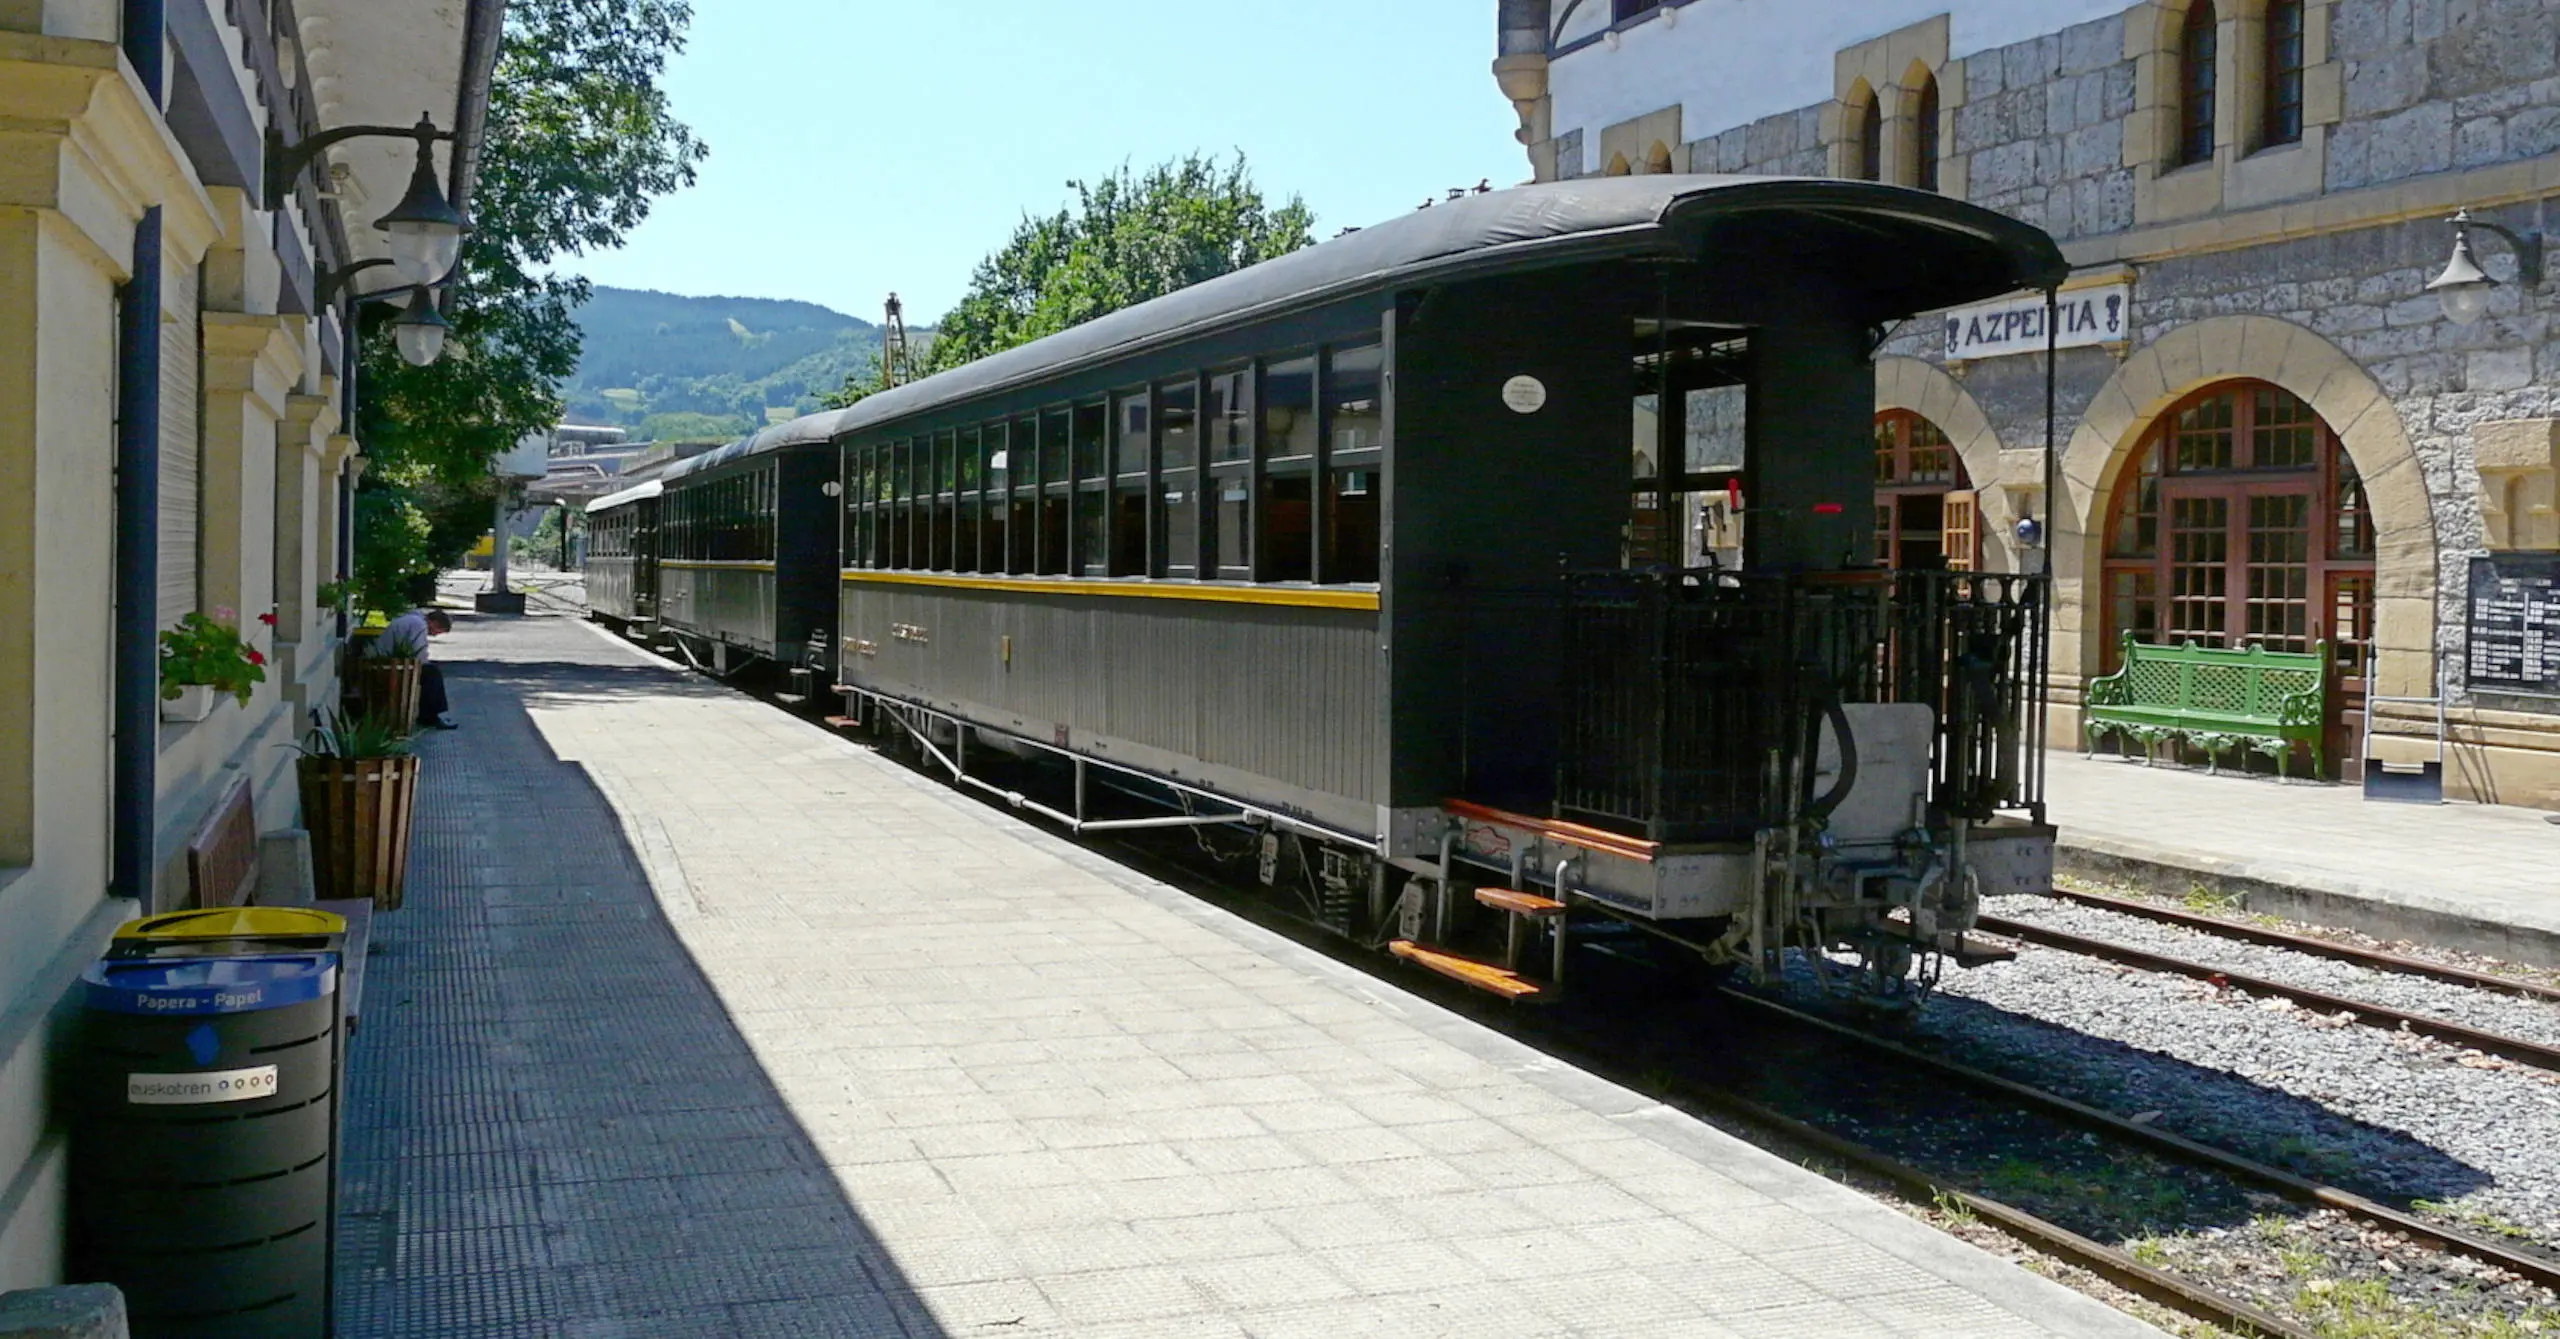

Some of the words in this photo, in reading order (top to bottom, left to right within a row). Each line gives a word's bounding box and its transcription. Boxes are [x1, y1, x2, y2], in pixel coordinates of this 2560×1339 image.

[137, 993, 197, 1011] Papera
[214, 989, 263, 1008] Papel
[130, 1081, 212, 1096] euskotren
